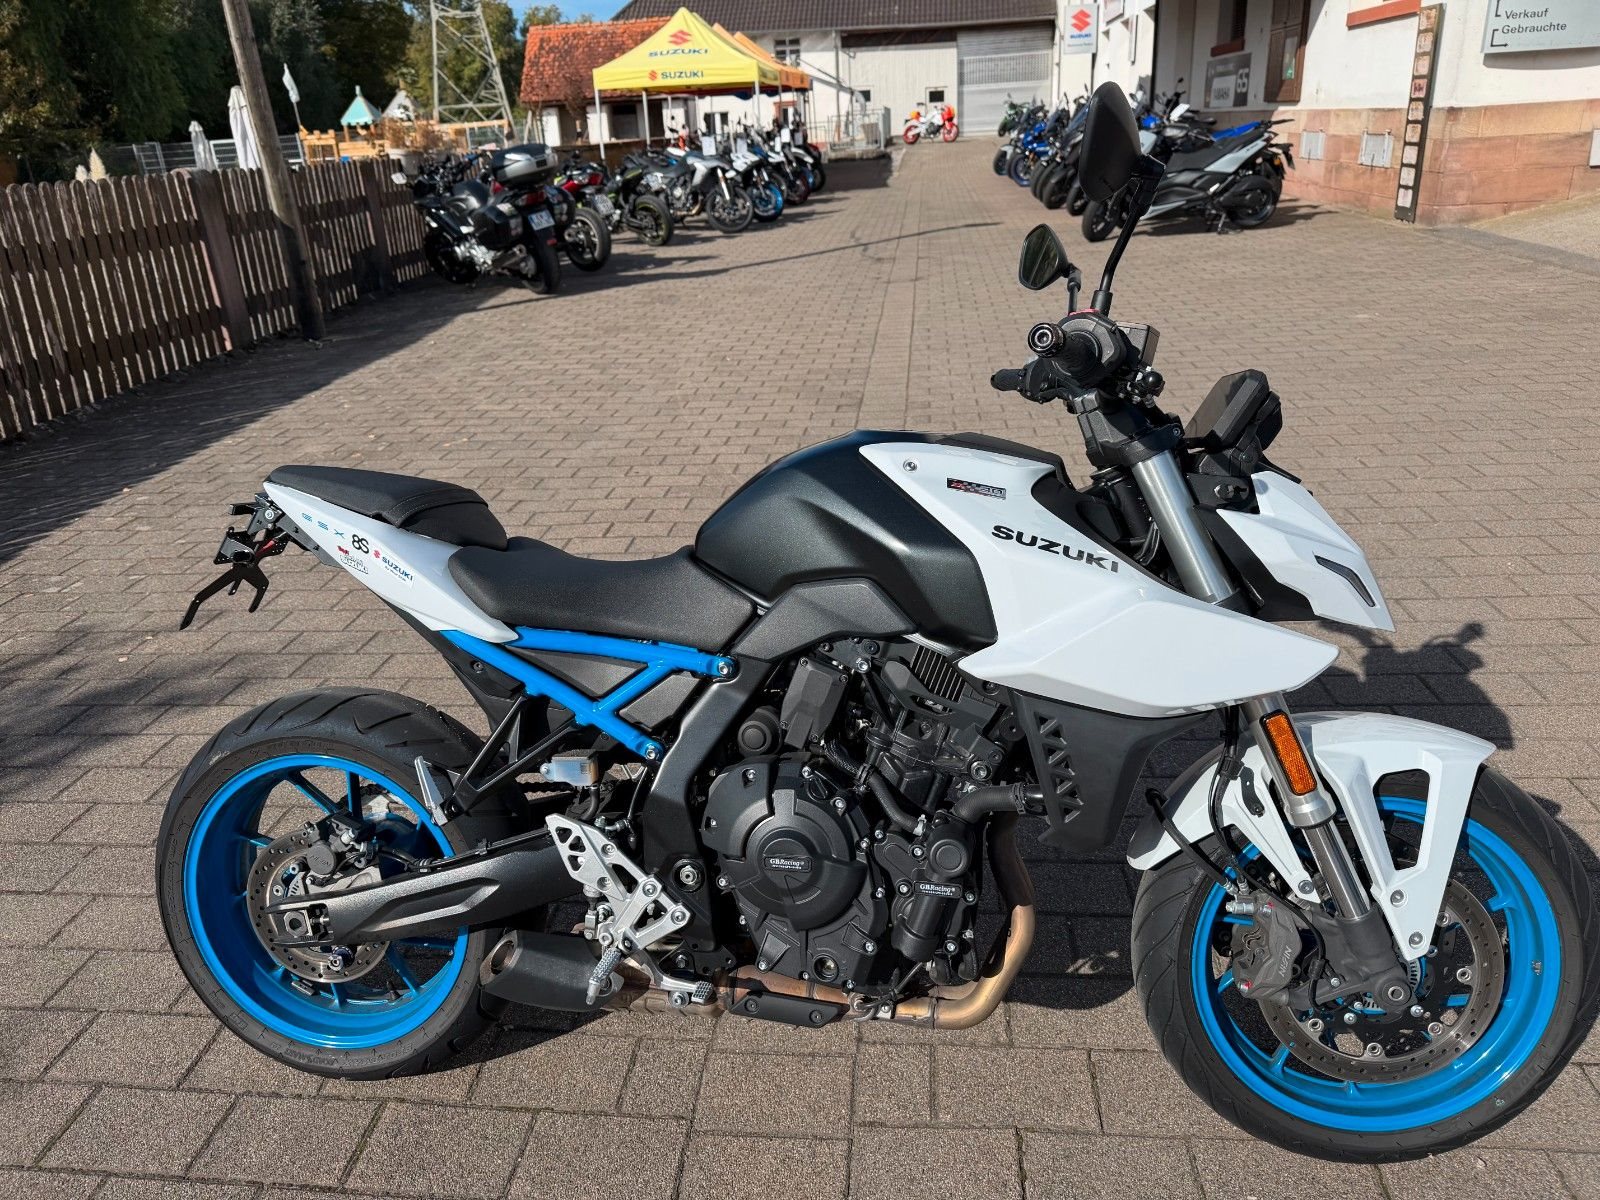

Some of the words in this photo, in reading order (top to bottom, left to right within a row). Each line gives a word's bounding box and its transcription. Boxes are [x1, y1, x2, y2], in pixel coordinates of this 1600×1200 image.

[1505, 8, 1549, 20] Verkauf
[1501, 22, 1567, 35] Gebrauchte
[649, 48, 708, 57] SUZUKI
[661, 70, 704, 79] SUZUKI
[352, 533, 370, 554] 8S
[991, 525, 1119, 573] SUZUKI
[382, 556, 413, 581] SUZUKI
